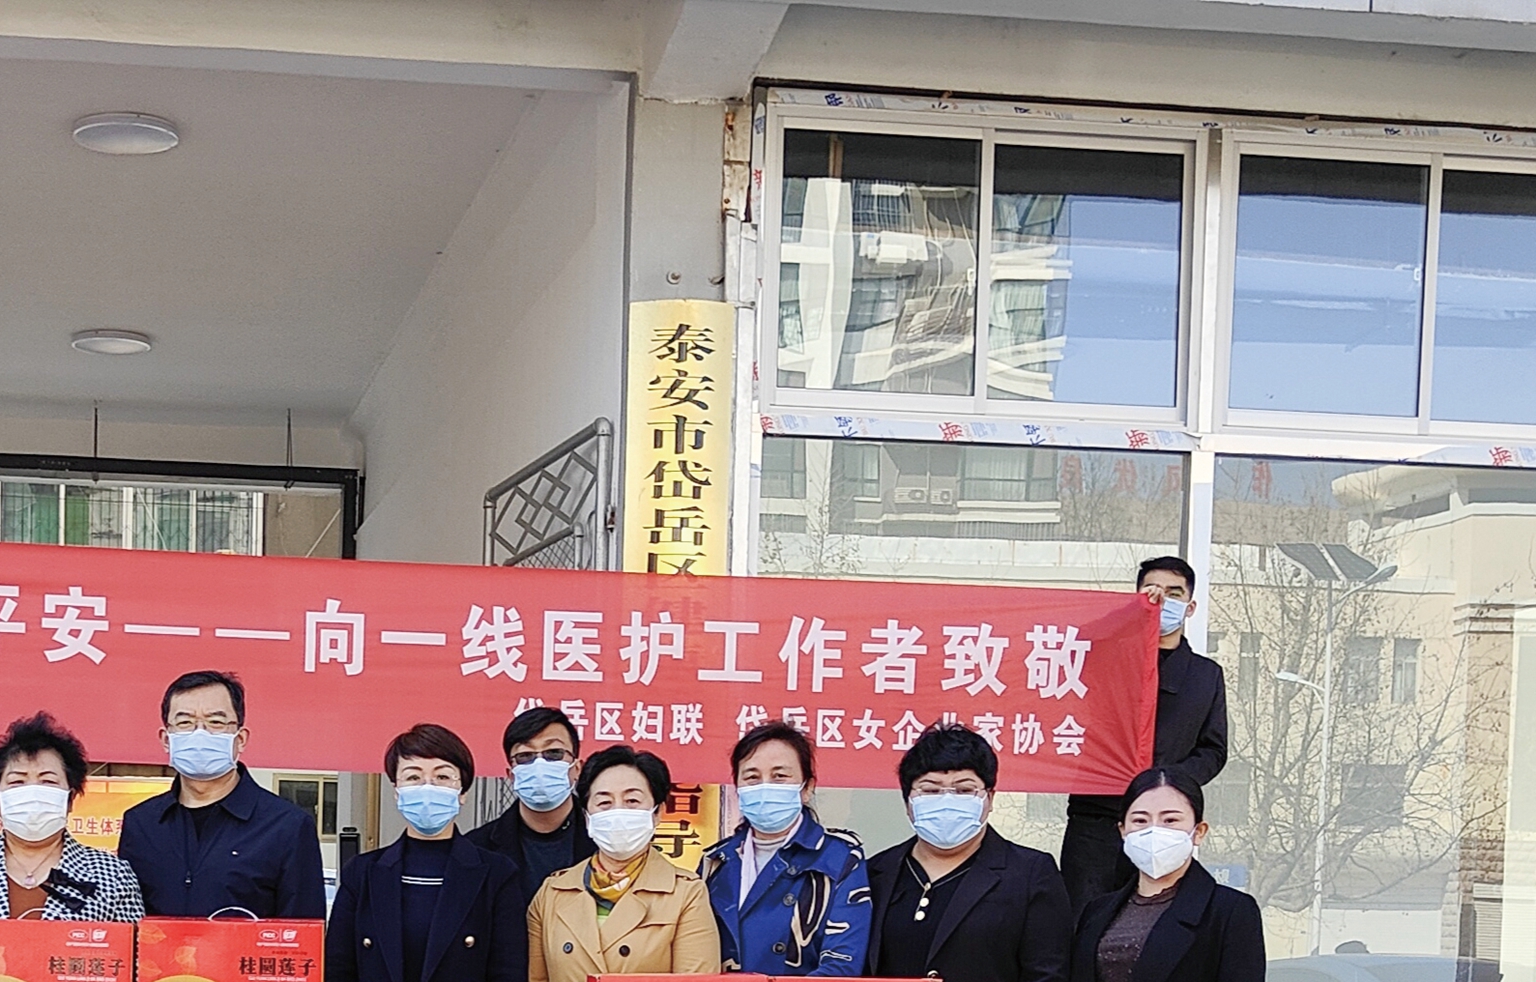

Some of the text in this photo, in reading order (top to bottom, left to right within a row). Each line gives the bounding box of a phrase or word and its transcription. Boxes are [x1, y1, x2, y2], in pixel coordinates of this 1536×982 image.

[643, 323, 714, 576] 泰安市岱岳区
